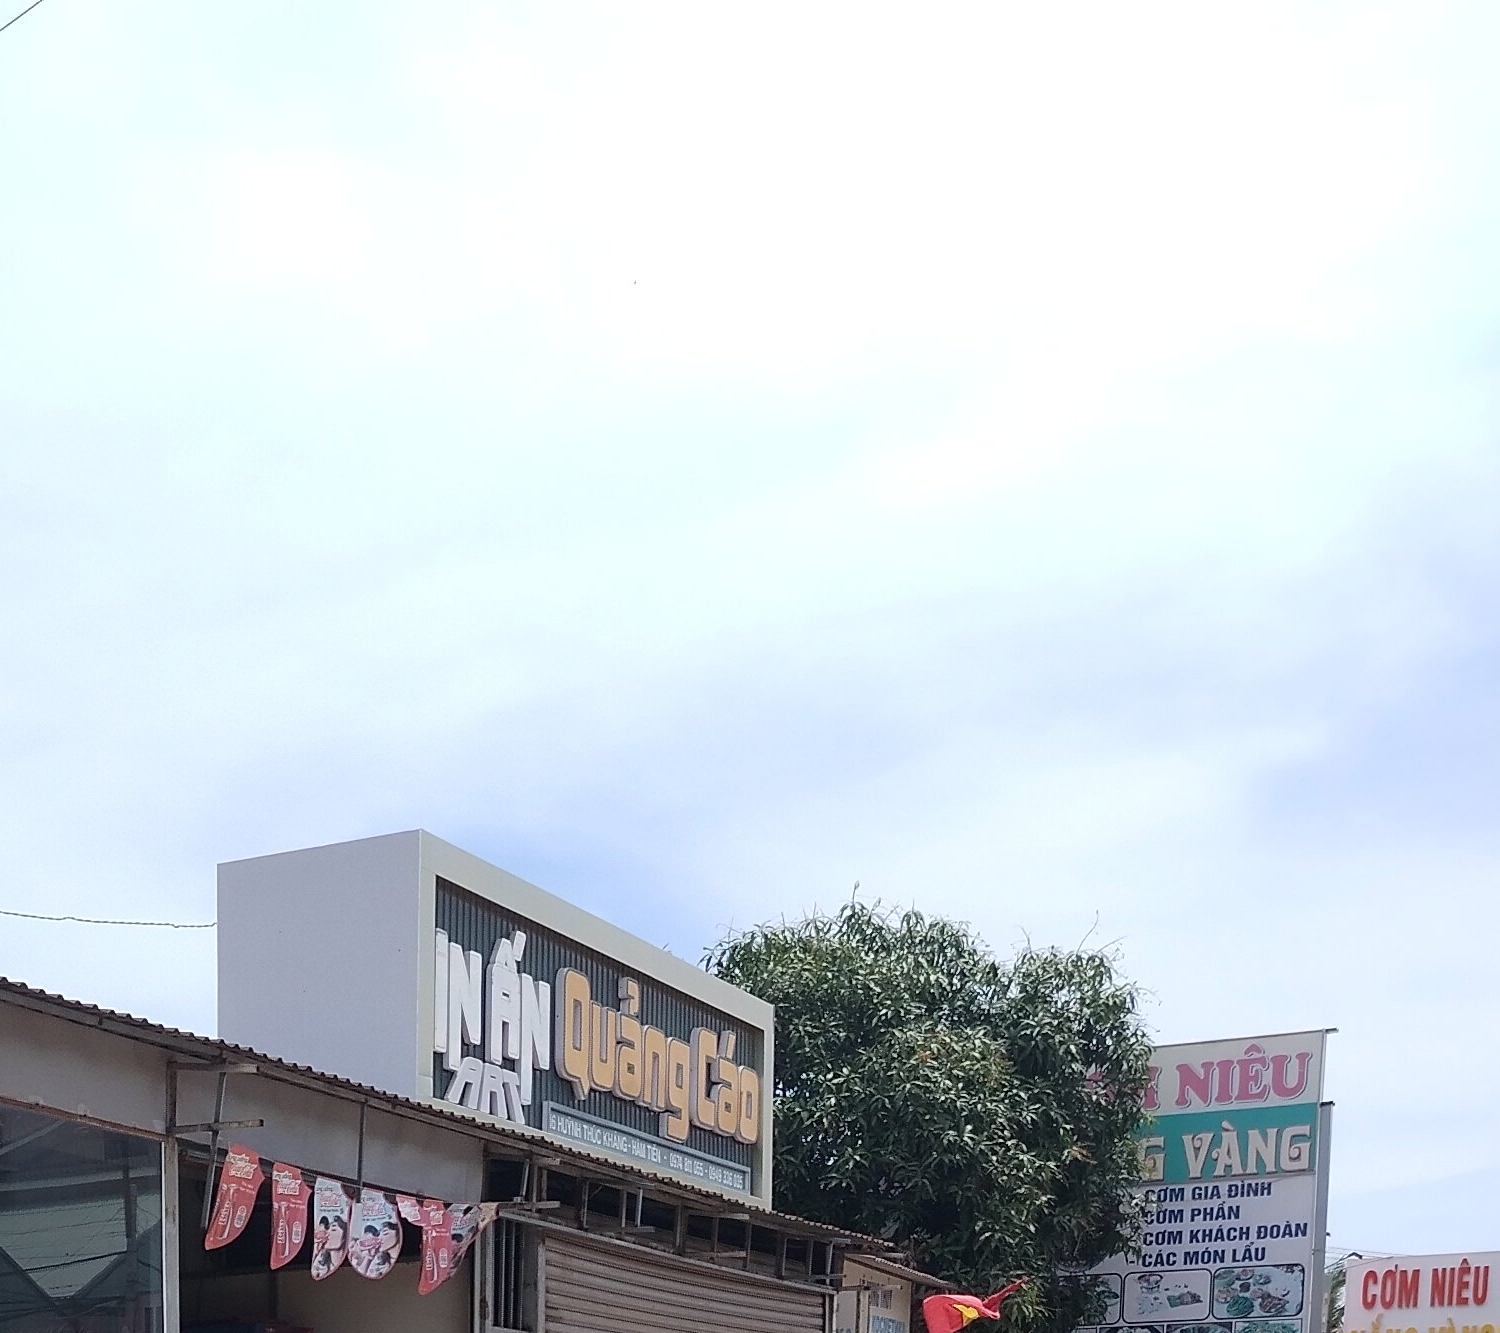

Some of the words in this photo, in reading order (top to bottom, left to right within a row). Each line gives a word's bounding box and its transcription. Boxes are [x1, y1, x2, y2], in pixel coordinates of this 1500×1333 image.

[554, 966, 691, 1143] Quảng
[689, 1026, 759, 1144] Cáo
[1174, 1043, 1312, 1107] NIÊU
[1182, 1120, 1311, 1179] VÀNG
[1192, 1185, 1221, 1201] GIA
[1227, 1180, 1272, 1198] ĐÌNH
[1141, 1249, 1177, 1267] CÁC
[1183, 1247, 1225, 1265] MÓN
[1143, 1230, 1183, 1246] CƠM
[1189, 1224, 1250, 1244] KHÁCH
[1256, 1220, 1308, 1240] ĐOÀN
[1361, 1263, 1421, 1310] CƠM
[1430, 1258, 1490, 1307] NIÊU
